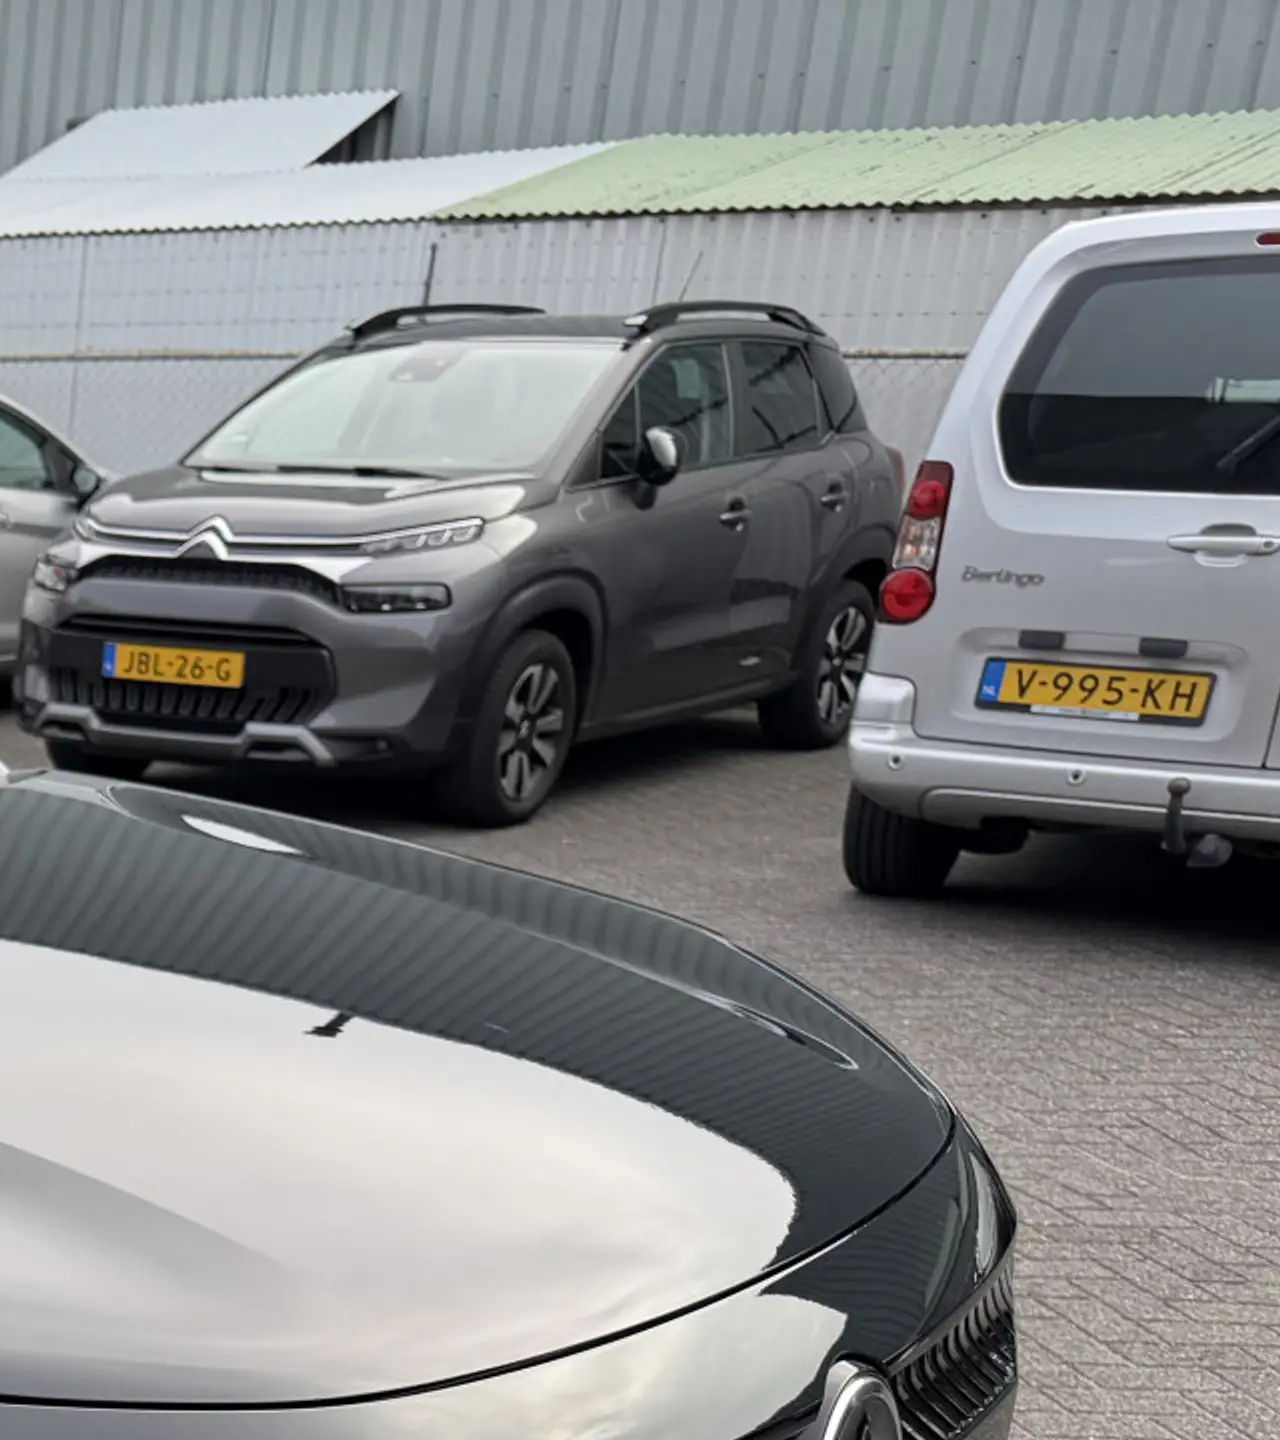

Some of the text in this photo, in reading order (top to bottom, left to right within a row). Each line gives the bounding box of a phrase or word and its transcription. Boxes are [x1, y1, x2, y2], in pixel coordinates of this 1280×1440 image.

[961, 565, 1045, 590] Berlingo
[123, 651, 231, 681] JBL-26-G
[1017, 669, 1198, 713] V-995-KH
